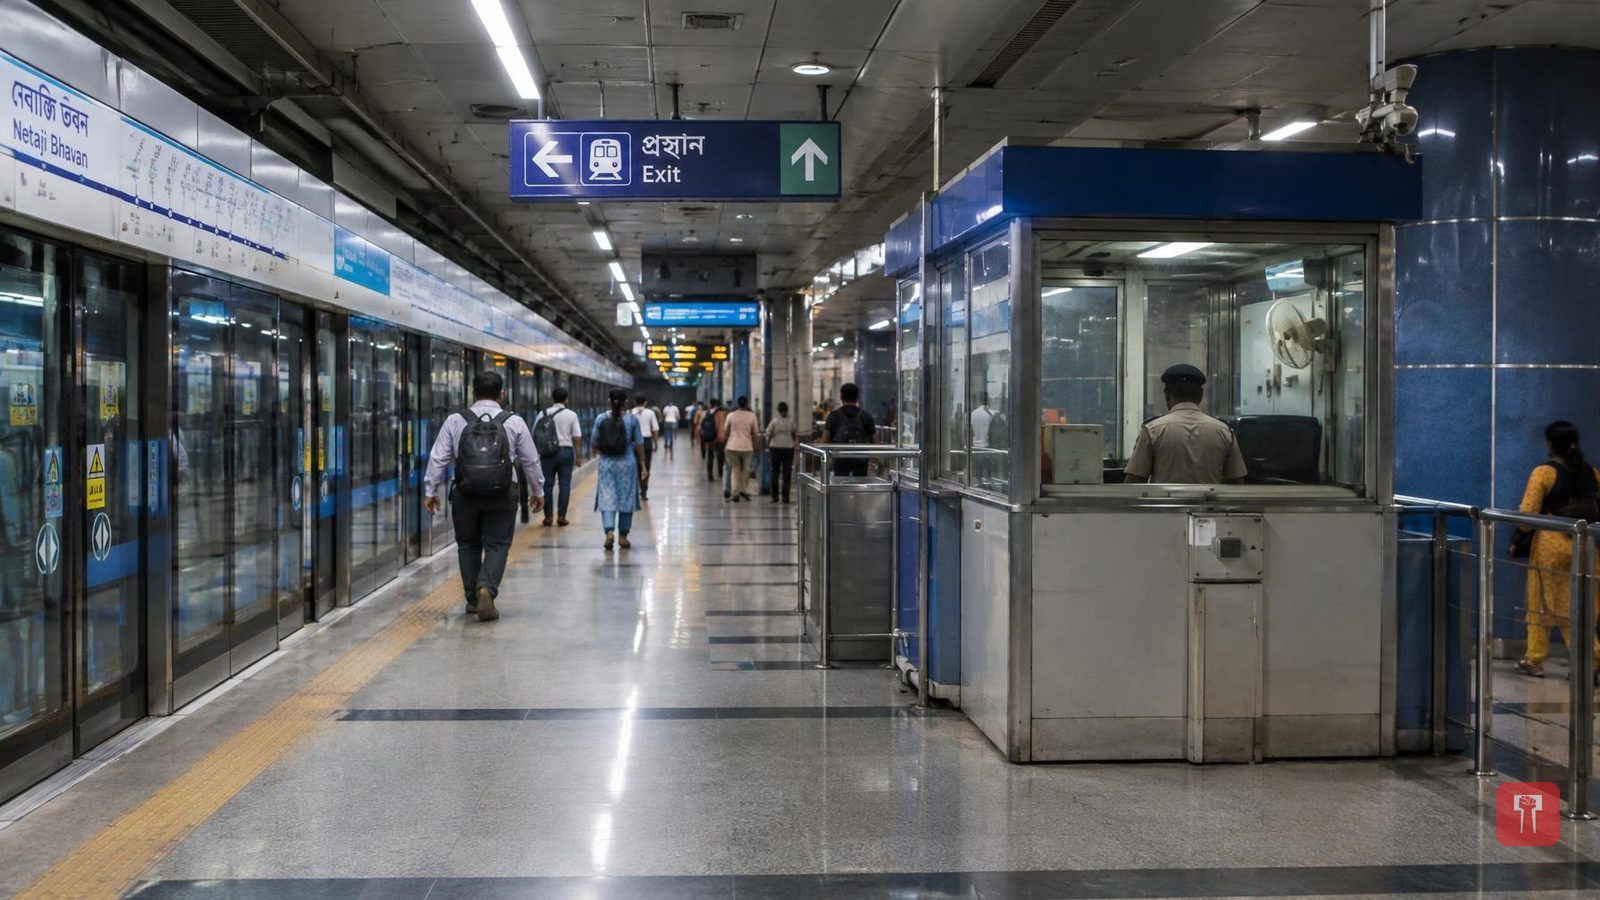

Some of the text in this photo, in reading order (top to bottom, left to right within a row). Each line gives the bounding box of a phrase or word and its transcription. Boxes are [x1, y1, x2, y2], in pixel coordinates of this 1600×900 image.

[13, 118, 88, 169] Netaji Bhavan
[642, 164, 681, 183] Exit
